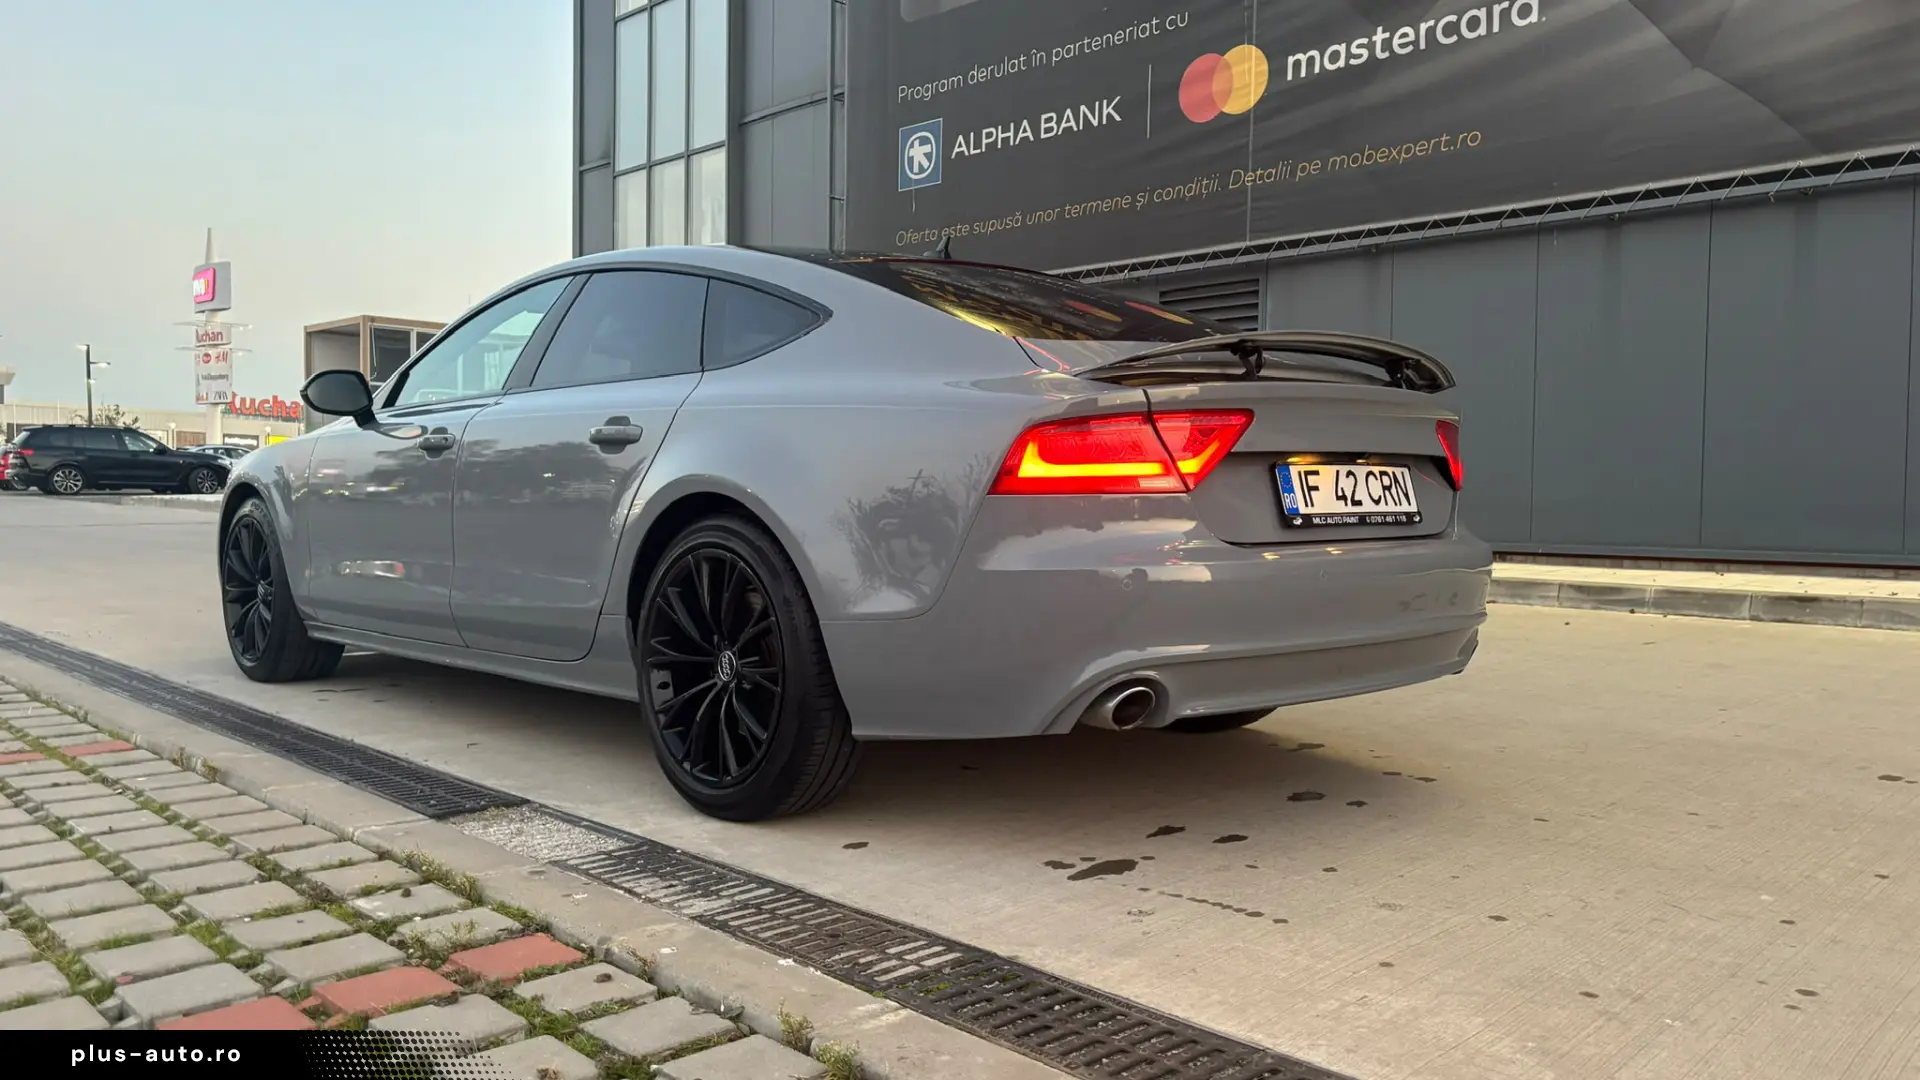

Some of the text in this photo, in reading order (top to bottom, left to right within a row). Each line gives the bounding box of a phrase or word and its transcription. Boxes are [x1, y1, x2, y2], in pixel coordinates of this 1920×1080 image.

[898, 11, 1189, 103] Program derulat în parteneriat cu
[951, 96, 1122, 159] ALPHA BANK
[895, 226, 938, 247] Oferta
[941, 220, 970, 239] este
[973, 210, 1023, 237] supusă
[1026, 205, 1061, 226] unor
[1064, 193, 1132, 219] termene
[1228, 160, 1293, 190] Detalii
[1296, 158, 1322, 181] pe
[1327, 130, 1482, 171] mobexpert.ro
[228, 391, 304, 419] ucha
[1284, 493, 1298, 509] RO
[1298, 469, 1412, 508] IF 42 CRN
[1327, 516, 1343, 524] AUTO
[1343, 515, 1360, 524] PAINT
